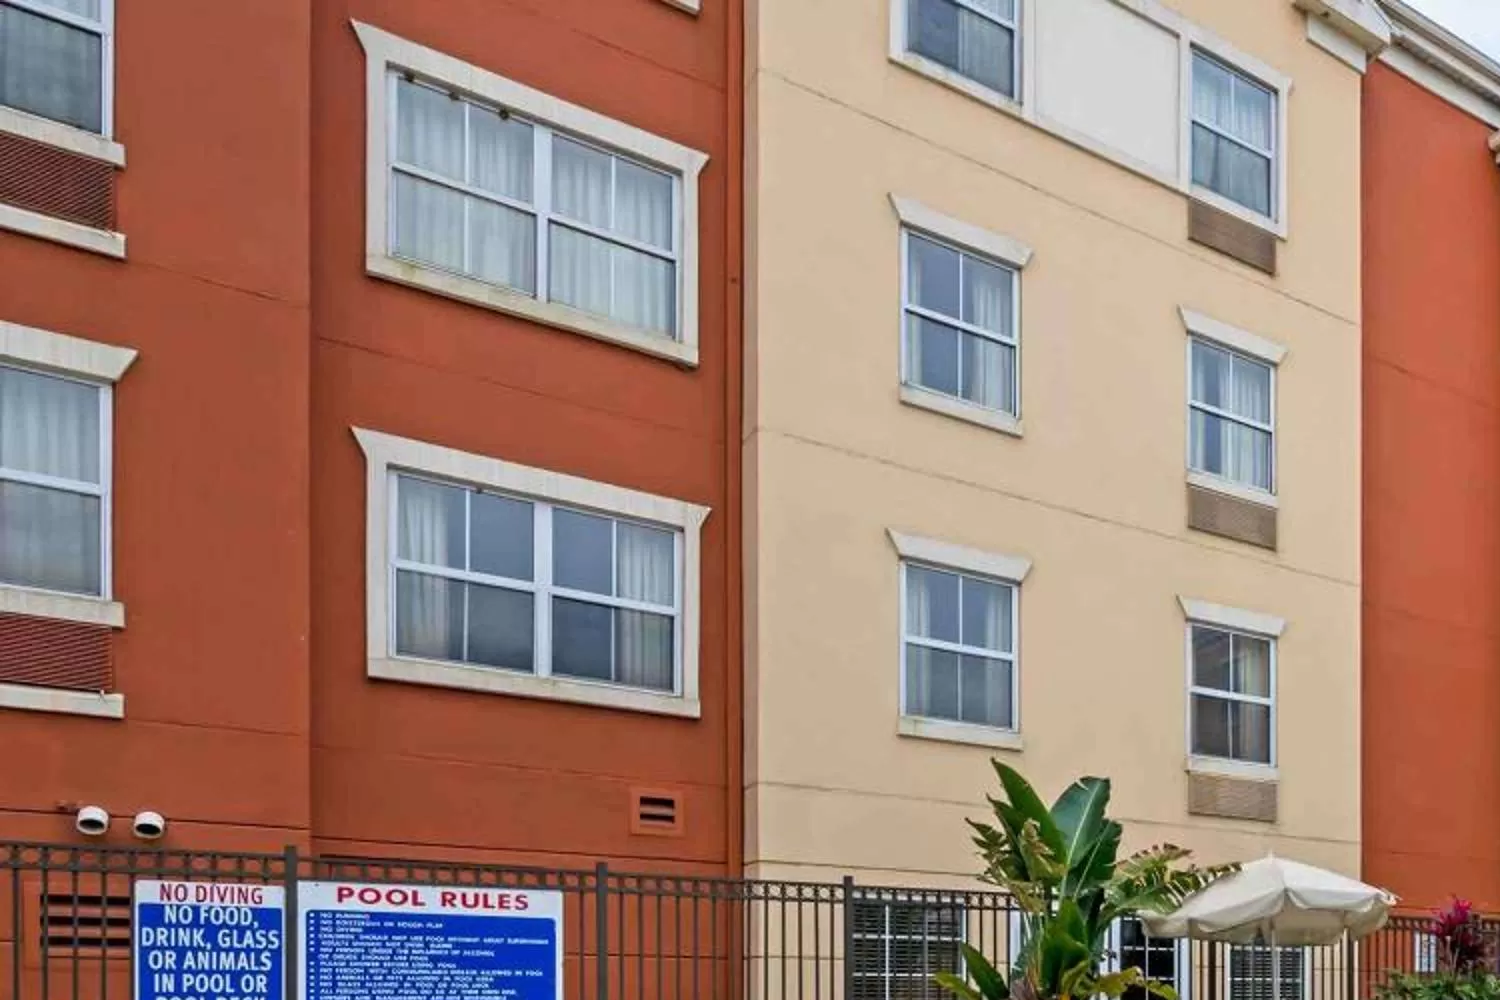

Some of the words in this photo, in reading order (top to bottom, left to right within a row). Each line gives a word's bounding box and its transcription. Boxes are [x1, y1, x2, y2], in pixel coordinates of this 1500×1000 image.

[160, 883, 188, 902] NO
[196, 885, 263, 904] DIVING
[337, 887, 426, 907] POOL
[441, 890, 529, 910] RULES
[164, 906, 193, 925] NO
[200, 907, 259, 928] FOOD,
[142, 927, 212, 950] DRINK,
[217, 929, 279, 949] GLASS
[148, 951, 176, 969] OR
[183, 952, 272, 971] ANIMALS
[154, 974, 174, 992] IN
[183, 974, 234, 993] POOL
[241, 974, 267, 993] OR
